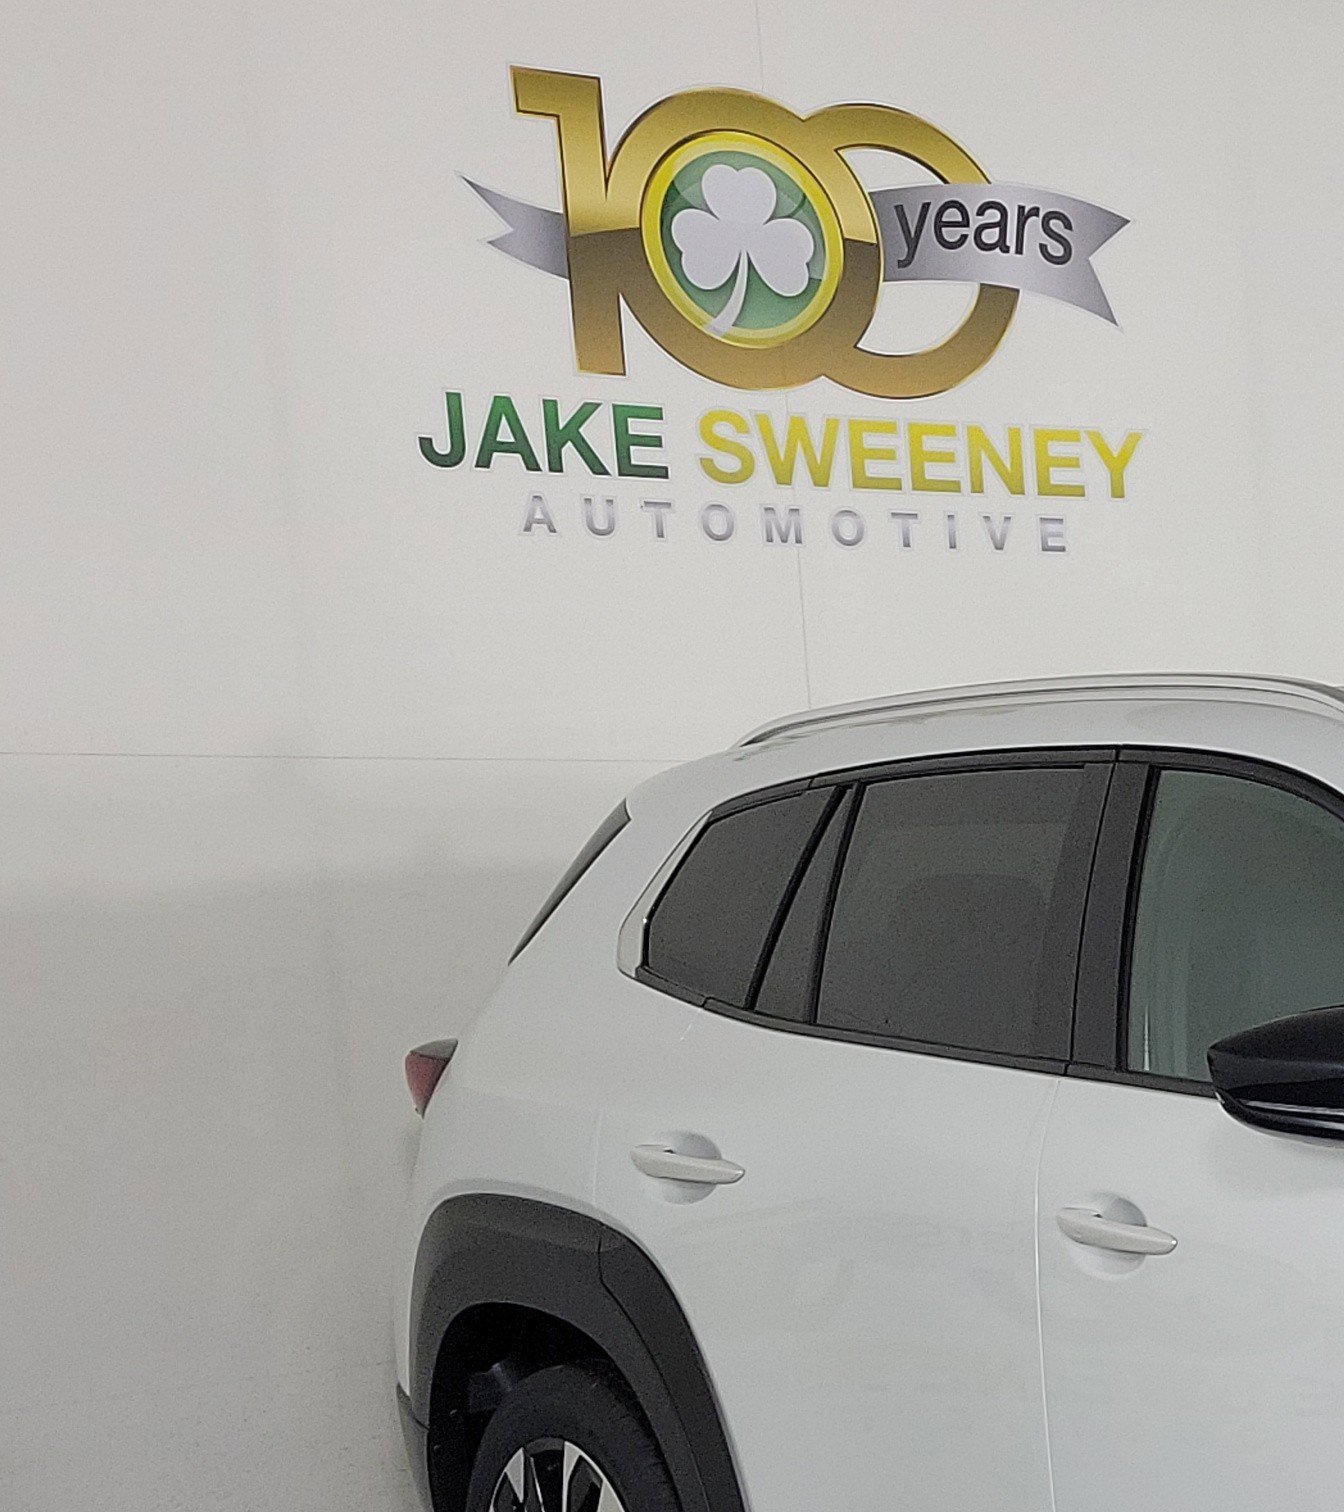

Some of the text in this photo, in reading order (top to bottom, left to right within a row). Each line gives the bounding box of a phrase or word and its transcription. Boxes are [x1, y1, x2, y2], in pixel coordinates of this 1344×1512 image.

[508, 65, 1074, 400] 100 years
[418, 391, 1143, 499] JAKE SWEENEY
[522, 494, 1067, 553] AUTOMOTIVE
